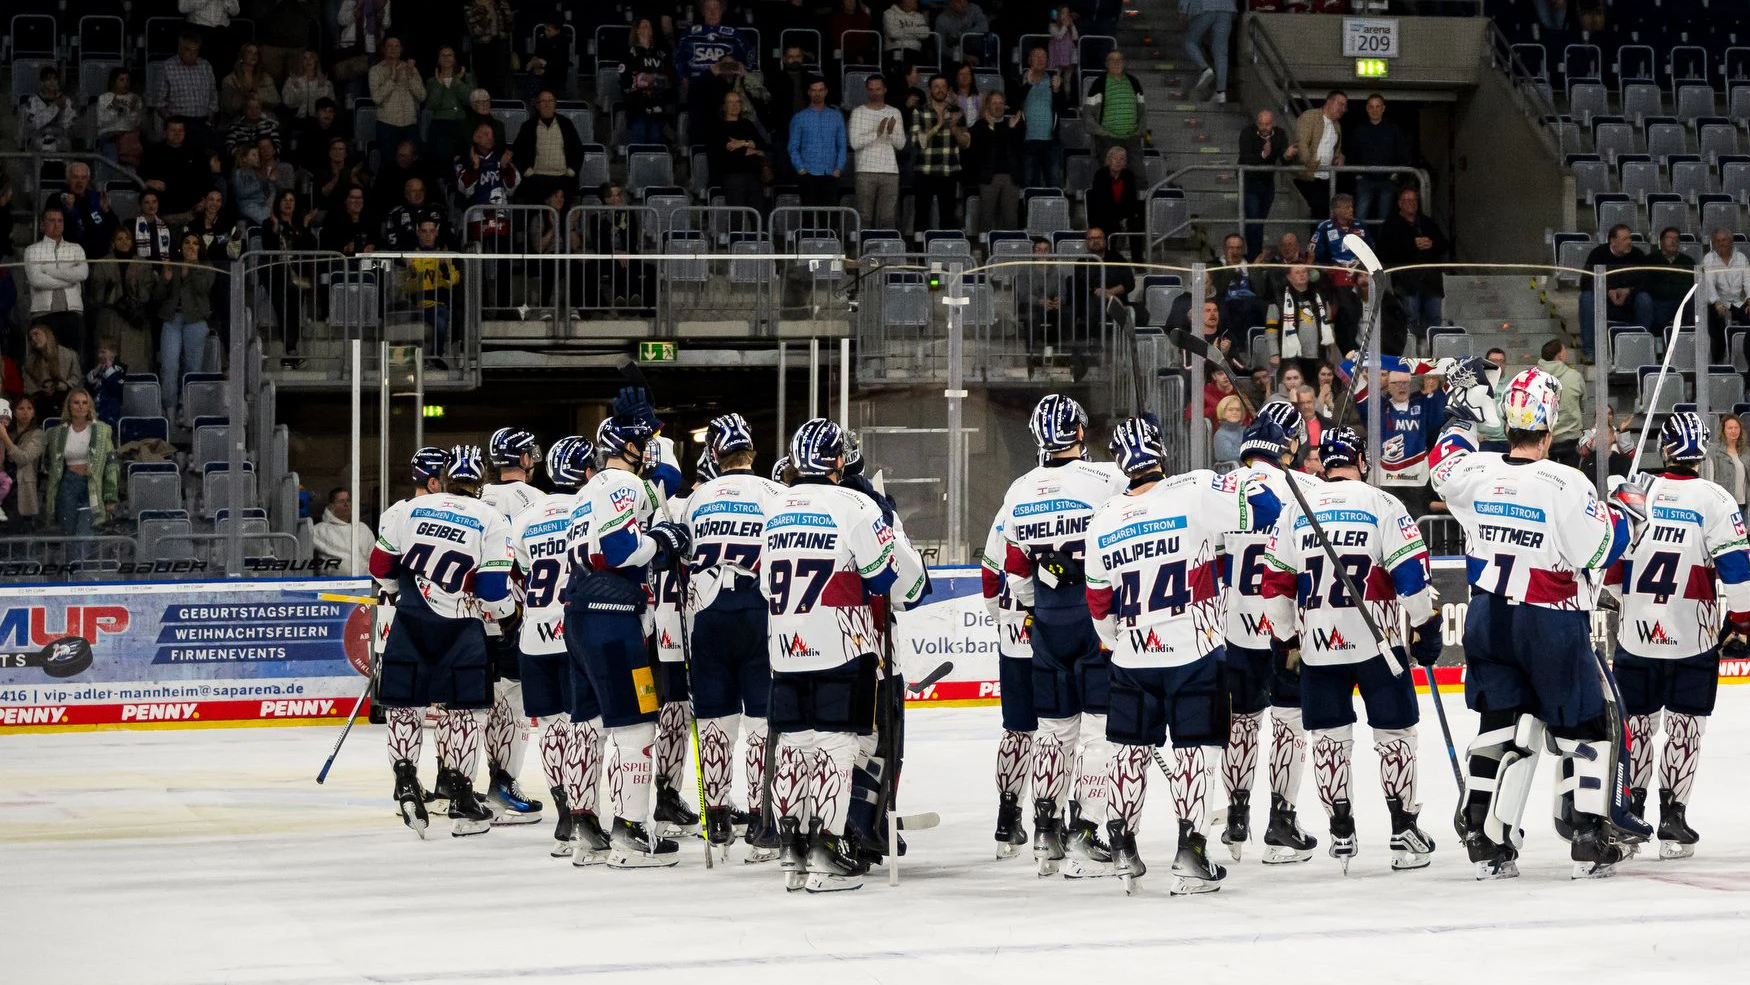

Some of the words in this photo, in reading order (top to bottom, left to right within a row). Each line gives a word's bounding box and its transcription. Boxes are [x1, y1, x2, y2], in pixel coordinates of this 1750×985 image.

[1359, 36, 1390, 51] 209
[695, 47, 726, 61] SAP
[723, 438, 750, 451] STADLER
[1127, 458, 1158, 472] STADLER
[1323, 454, 1349, 465] STADLER
[1077, 466, 1112, 479] structure
[1537, 471, 1567, 486] structure
[733, 503, 762, 514] STROM
[1014, 503, 1049, 515] EISBÄREN
[1510, 506, 1540, 519] STROM
[454, 515, 480, 528] STROM
[802, 515, 834, 526] STROM
[1016, 514, 1094, 541] IEMELÄINE
[1143, 519, 1176, 534] STROM
[416, 522, 467, 545] GEIBEL
[694, 519, 763, 540] HÖRDLER
[768, 532, 838, 552] FONTAINE
[691, 543, 762, 574] 77
[1102, 535, 1180, 572] GALIPEAU
[400, 543, 475, 594] 40
[1494, 553, 1517, 597] 1
[1304, 554, 1373, 609] 18
[1636, 552, 1681, 604] 4
[769, 558, 836, 615] 97
[1120, 559, 1193, 628] 44
[179, 605, 341, 620] GEBURTSTAGSFEIERN
[588, 602, 636, 612] WARRIOR
[964, 611, 994, 627] Die
[175, 626, 329, 640] WEIHNACHTSFEIERN
[171, 647, 286, 661] FIRMENEVENTS
[44, 683, 304, 702] vip-adler-mannheim@saparena.de
[1615, 762, 1625, 807] WARRIOR
